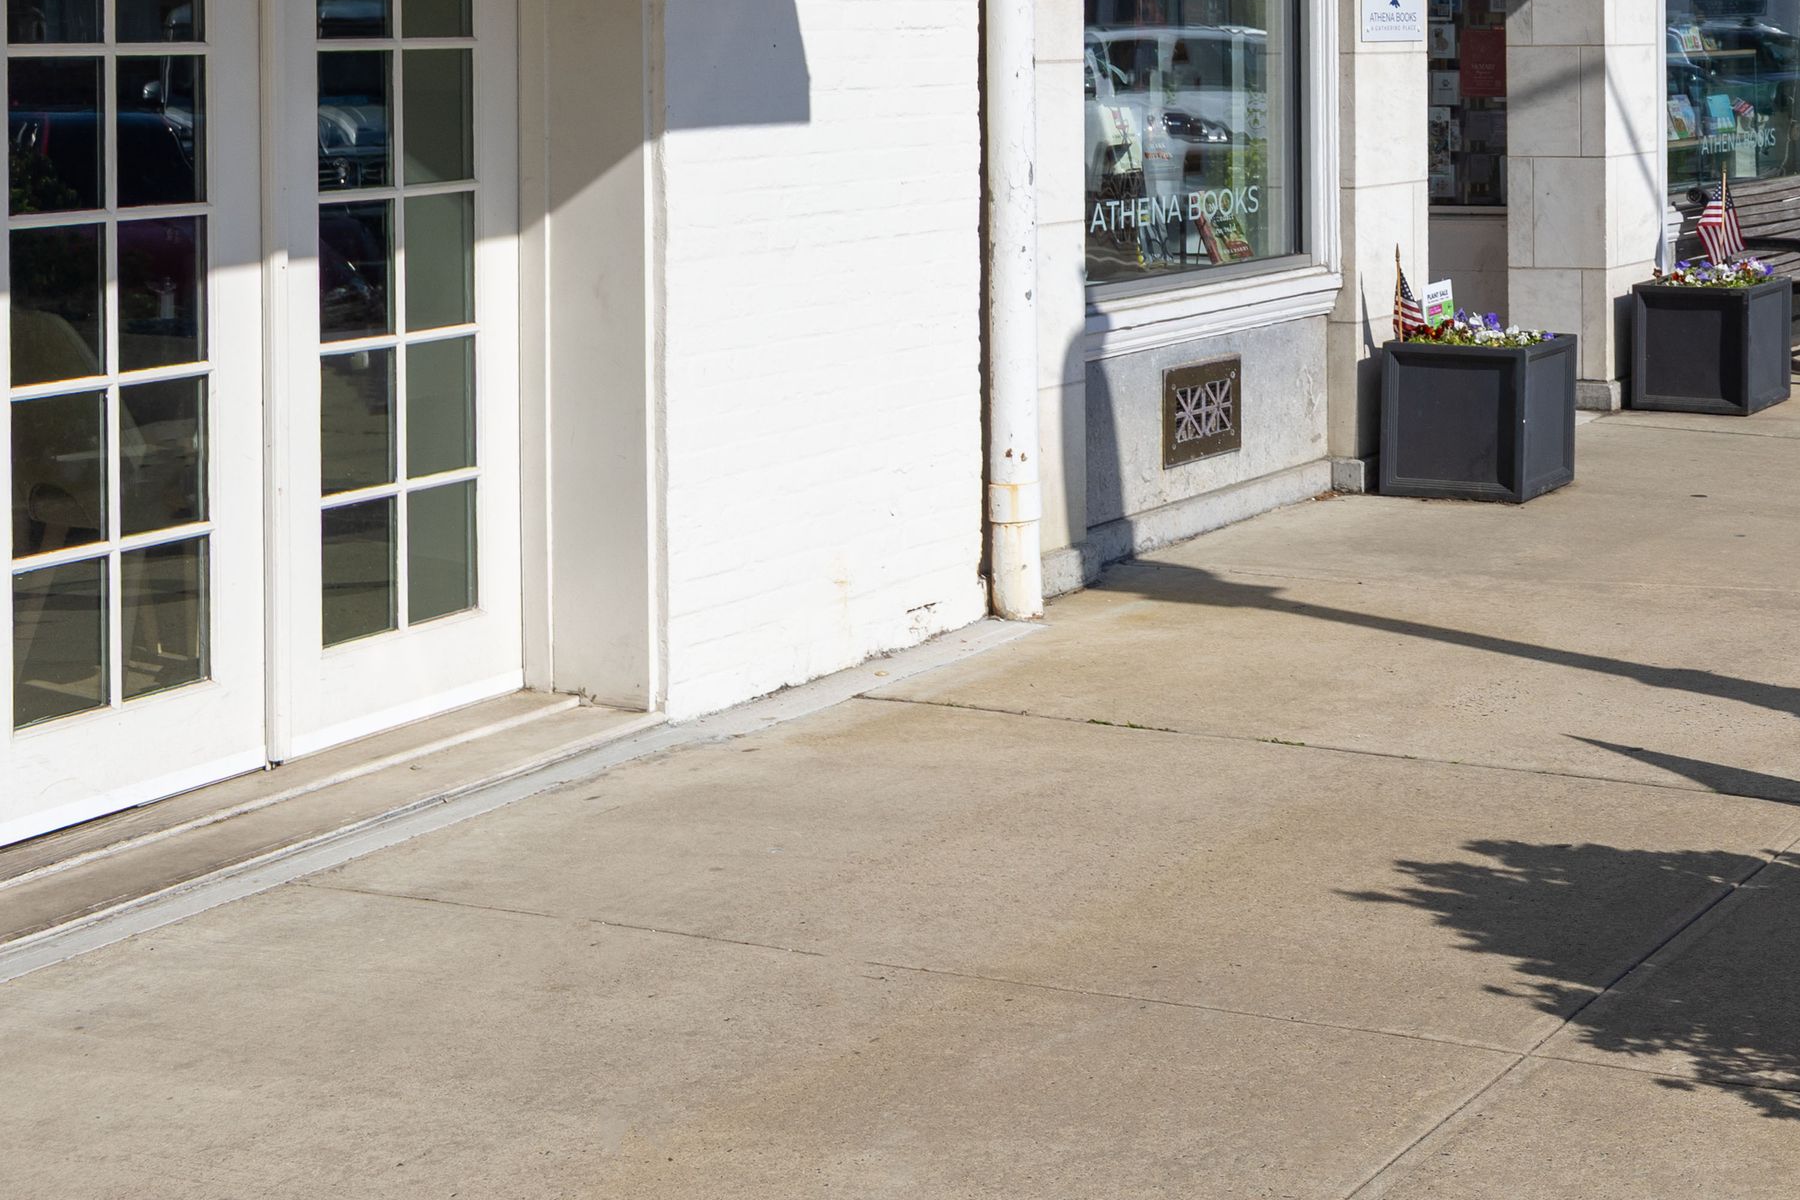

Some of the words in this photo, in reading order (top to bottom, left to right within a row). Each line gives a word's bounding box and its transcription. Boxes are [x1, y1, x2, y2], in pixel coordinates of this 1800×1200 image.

[1370, 12, 1395, 22] ATHENA
[1396, 12, 1416, 22] BOOKS
[1701, 133, 1741, 155] ATHENA
[1743, 128, 1776, 149] BOOKS
[1090, 194, 1182, 233] ATHENA
[1188, 186, 1259, 220] BOOKS
